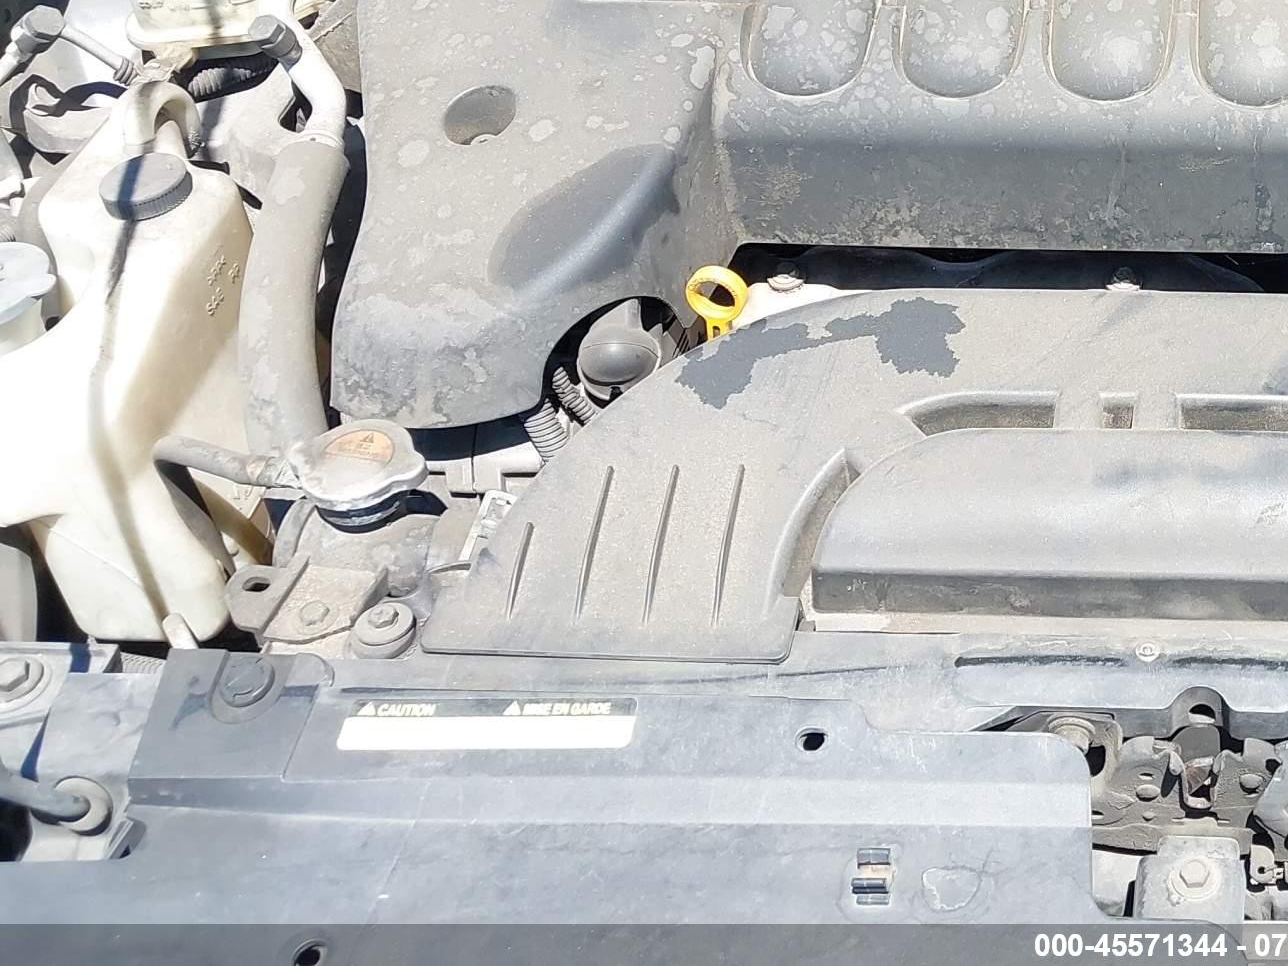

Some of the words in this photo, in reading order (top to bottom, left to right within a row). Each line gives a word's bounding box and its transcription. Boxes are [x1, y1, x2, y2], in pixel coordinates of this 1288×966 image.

[377, 703, 437, 717] CAUTION
[552, 703, 571, 716] EN
[571, 702, 612, 715] GARDE
